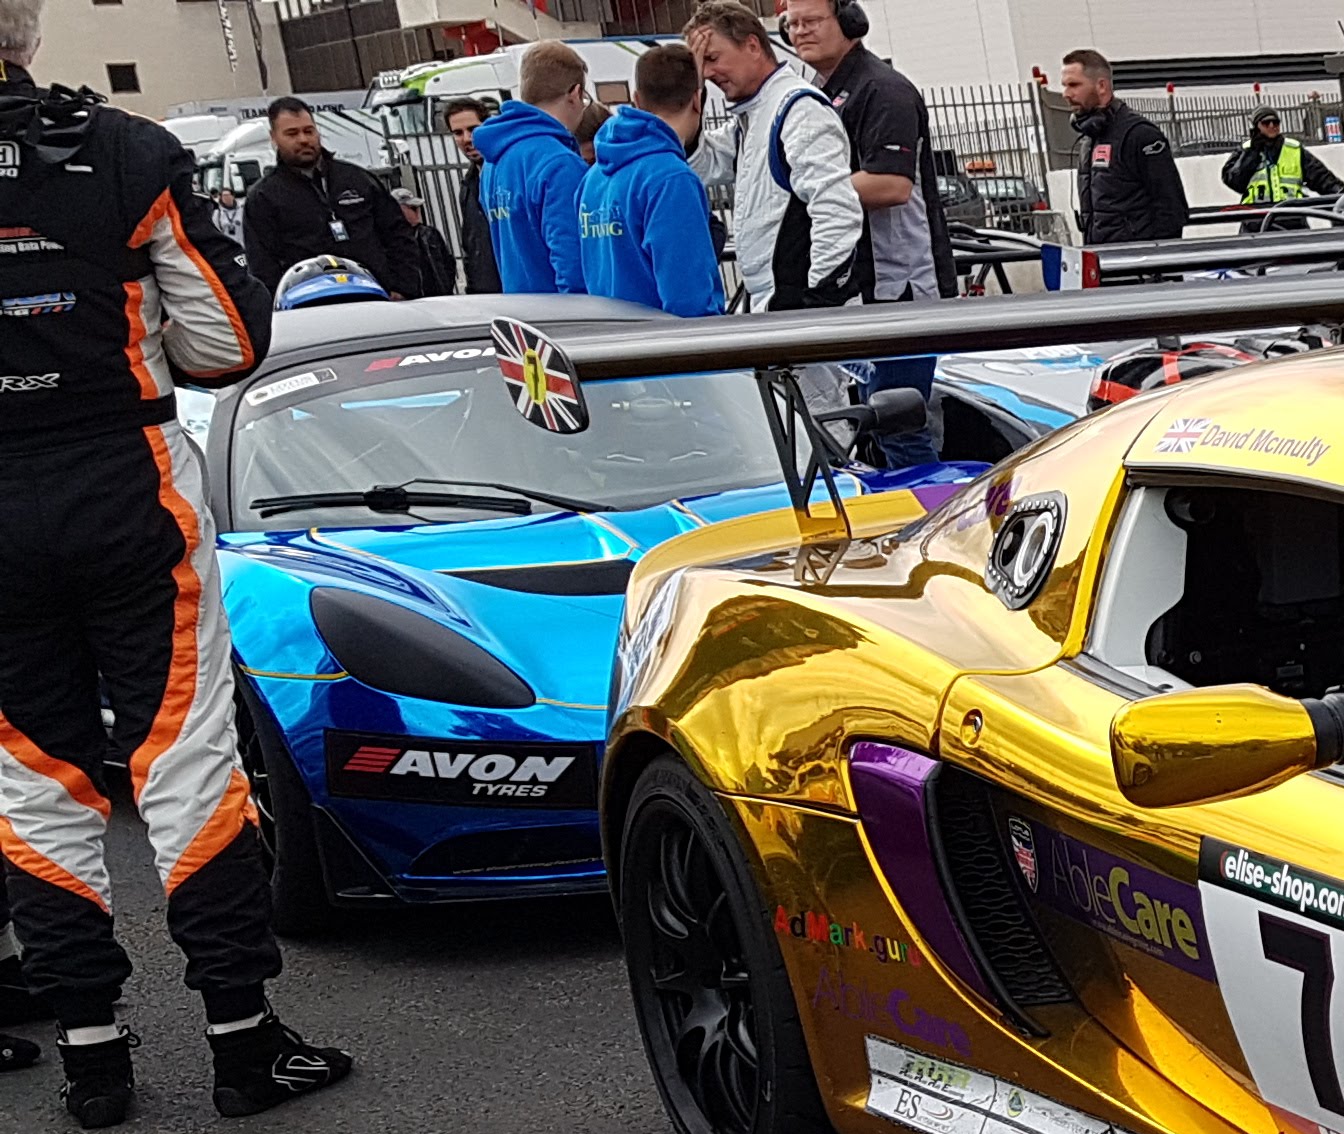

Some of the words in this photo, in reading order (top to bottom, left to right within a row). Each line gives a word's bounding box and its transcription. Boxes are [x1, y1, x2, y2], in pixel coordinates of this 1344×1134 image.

[398, 347, 497, 366] AVO
[1200, 425, 1255, 450] David
[390, 749, 575, 782] AVON
[472, 783, 549, 797] TYRES
[1051, 839, 1200, 960] AbleCare
[774, 905, 922, 968] AdMark.guru
[894, 1088, 922, 1119] ES
